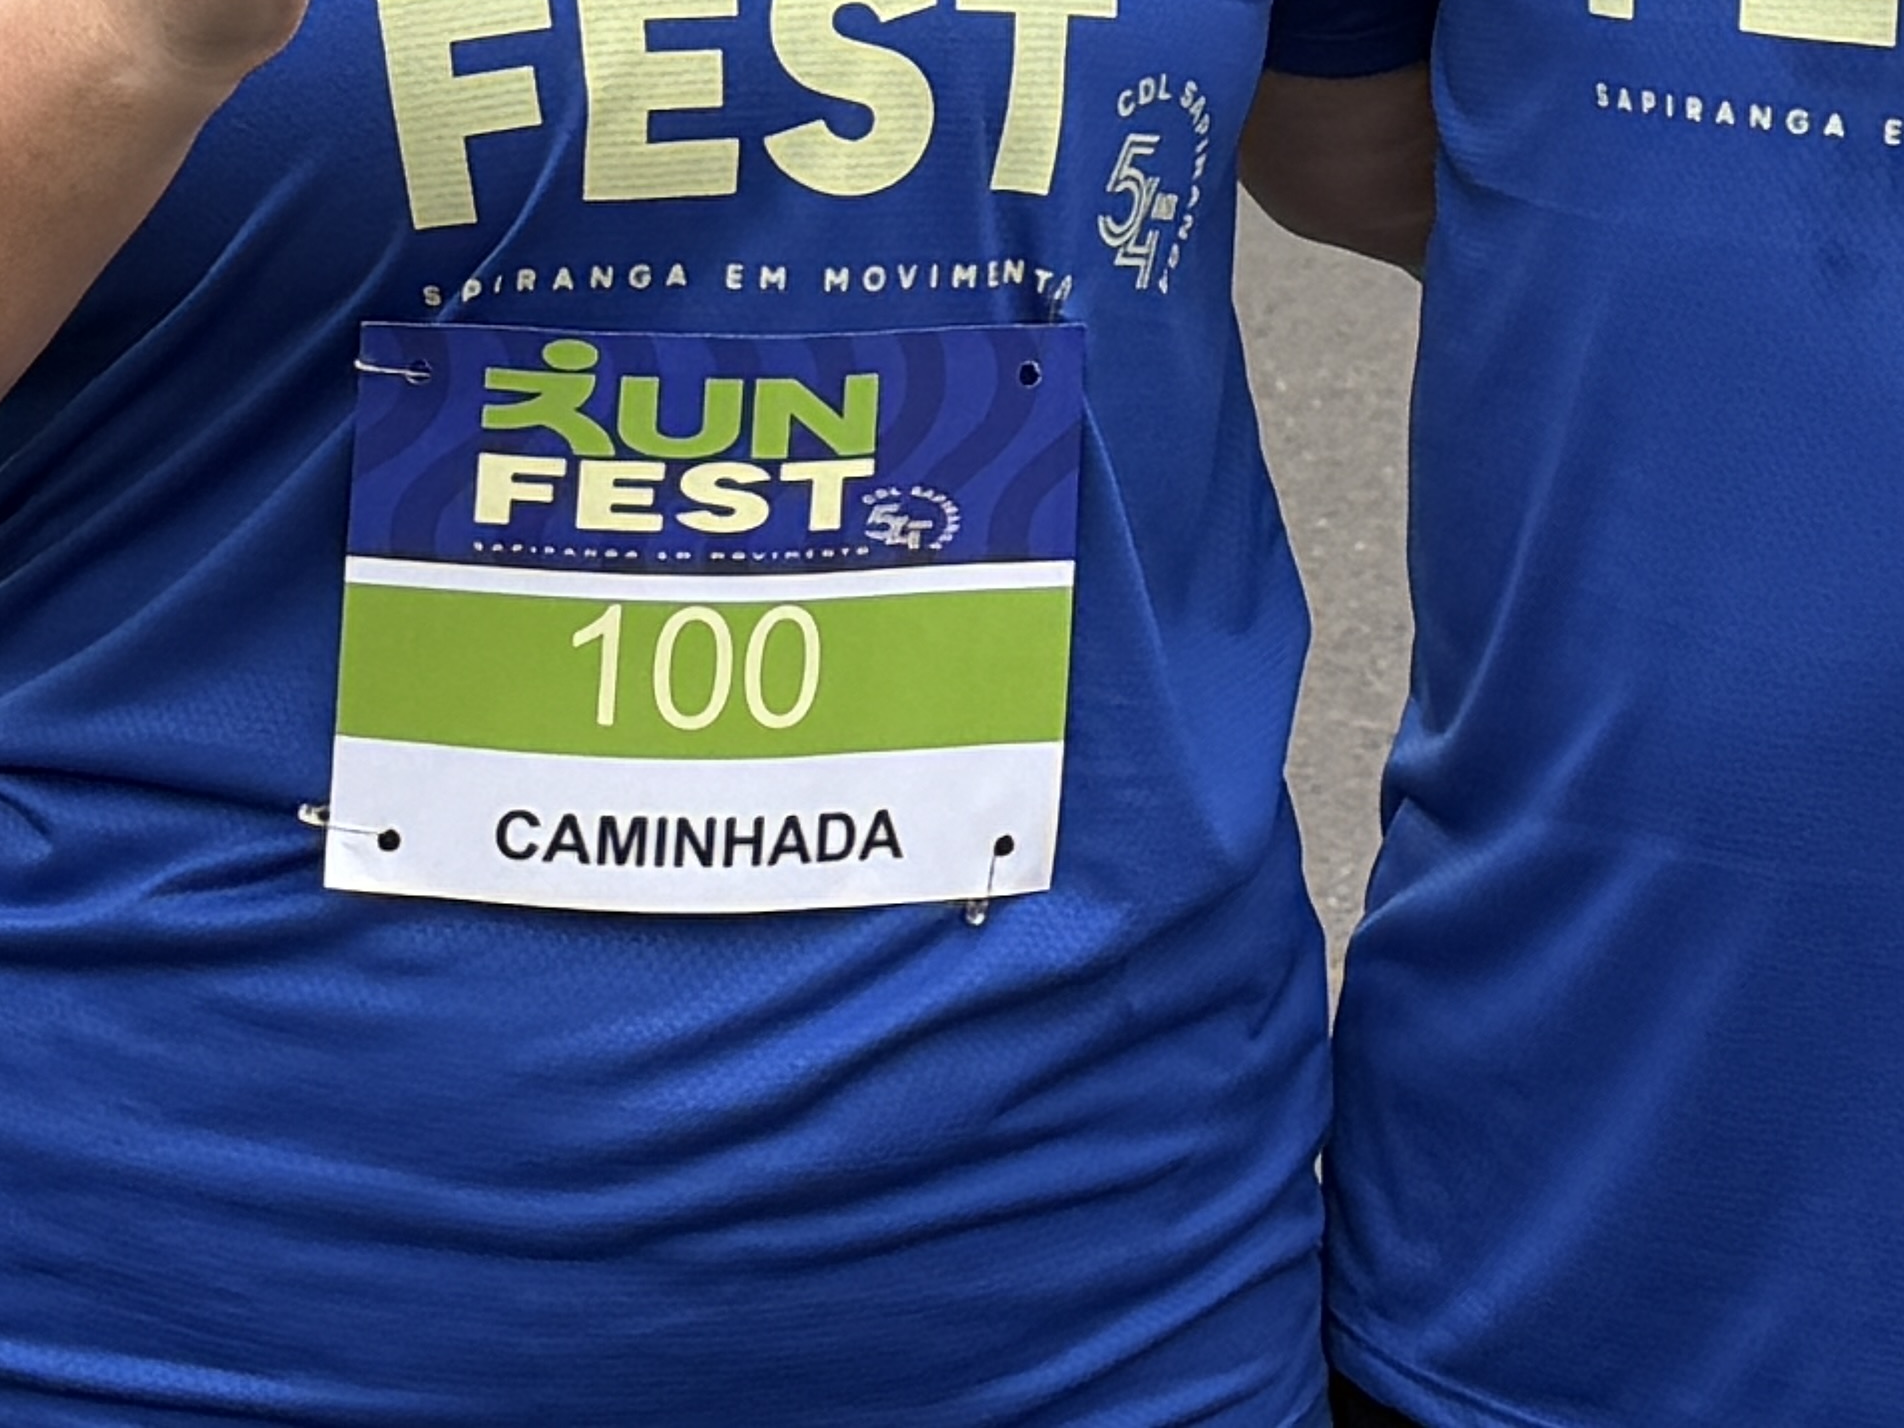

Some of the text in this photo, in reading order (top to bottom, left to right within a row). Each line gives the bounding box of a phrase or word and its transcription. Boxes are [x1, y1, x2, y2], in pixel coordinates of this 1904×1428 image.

[1116, 73, 1172, 117] CDL
[1595, 82, 1845, 138] SAPIRANGA
[422, 262, 688, 308] SPIRANGA
[726, 263, 787, 291] EM
[481, 338, 880, 460] RUN
[473, 453, 876, 534] FEST
[571, 602, 822, 732] 100
[495, 807, 904, 870] CAMINHADA
